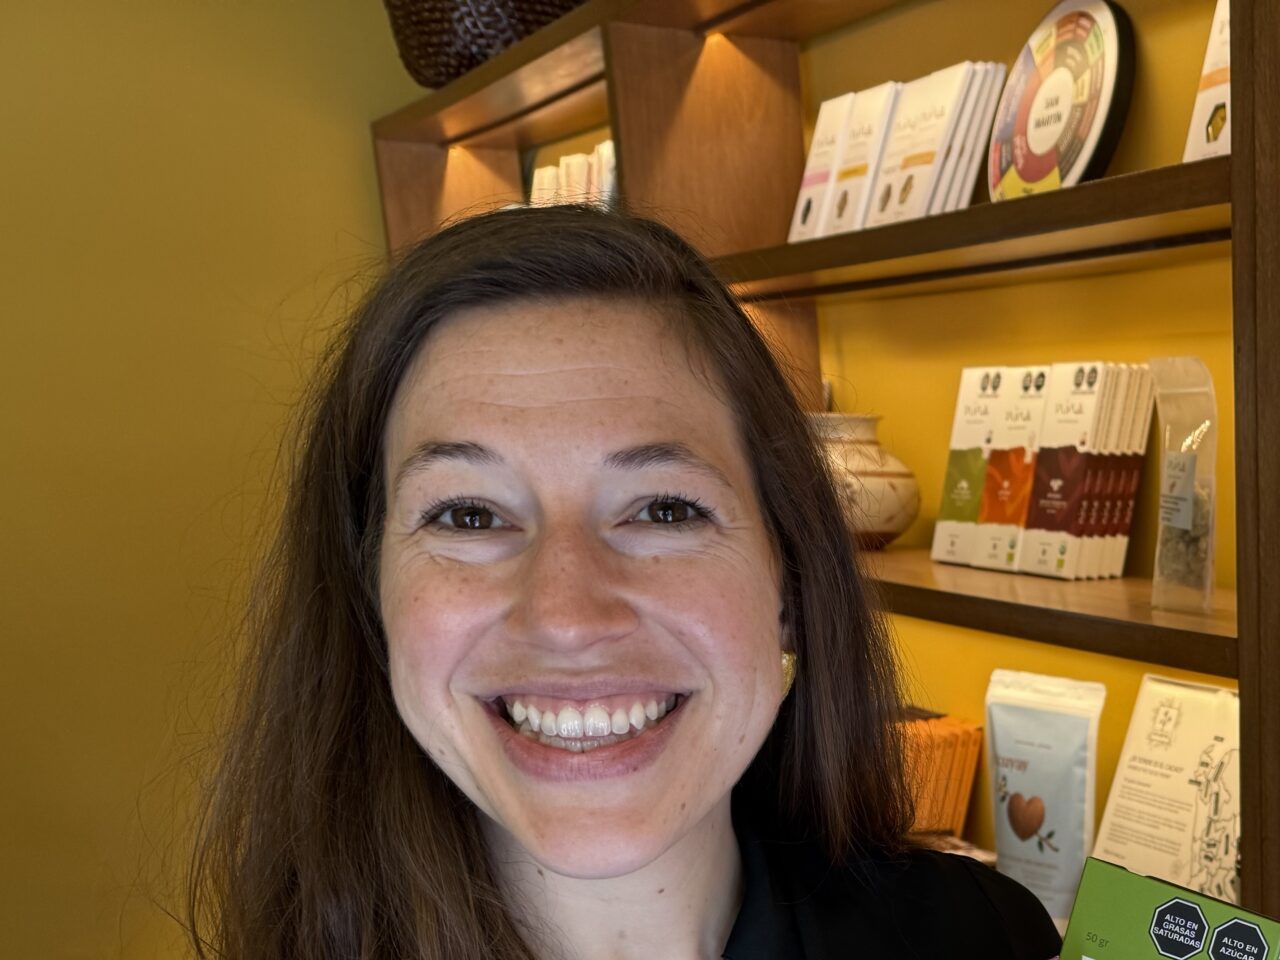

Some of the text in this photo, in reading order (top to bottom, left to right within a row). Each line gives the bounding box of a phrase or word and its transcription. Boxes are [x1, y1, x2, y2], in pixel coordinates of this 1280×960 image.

[1163, 922, 1196, 938] GRASAS
[1164, 914, 1199, 930] ALTO EN
[1086, 932, 1110, 948] 50 gr
[1153, 927, 1201, 948] SATURADAS
[1222, 936, 1258, 953] ALTO EN
